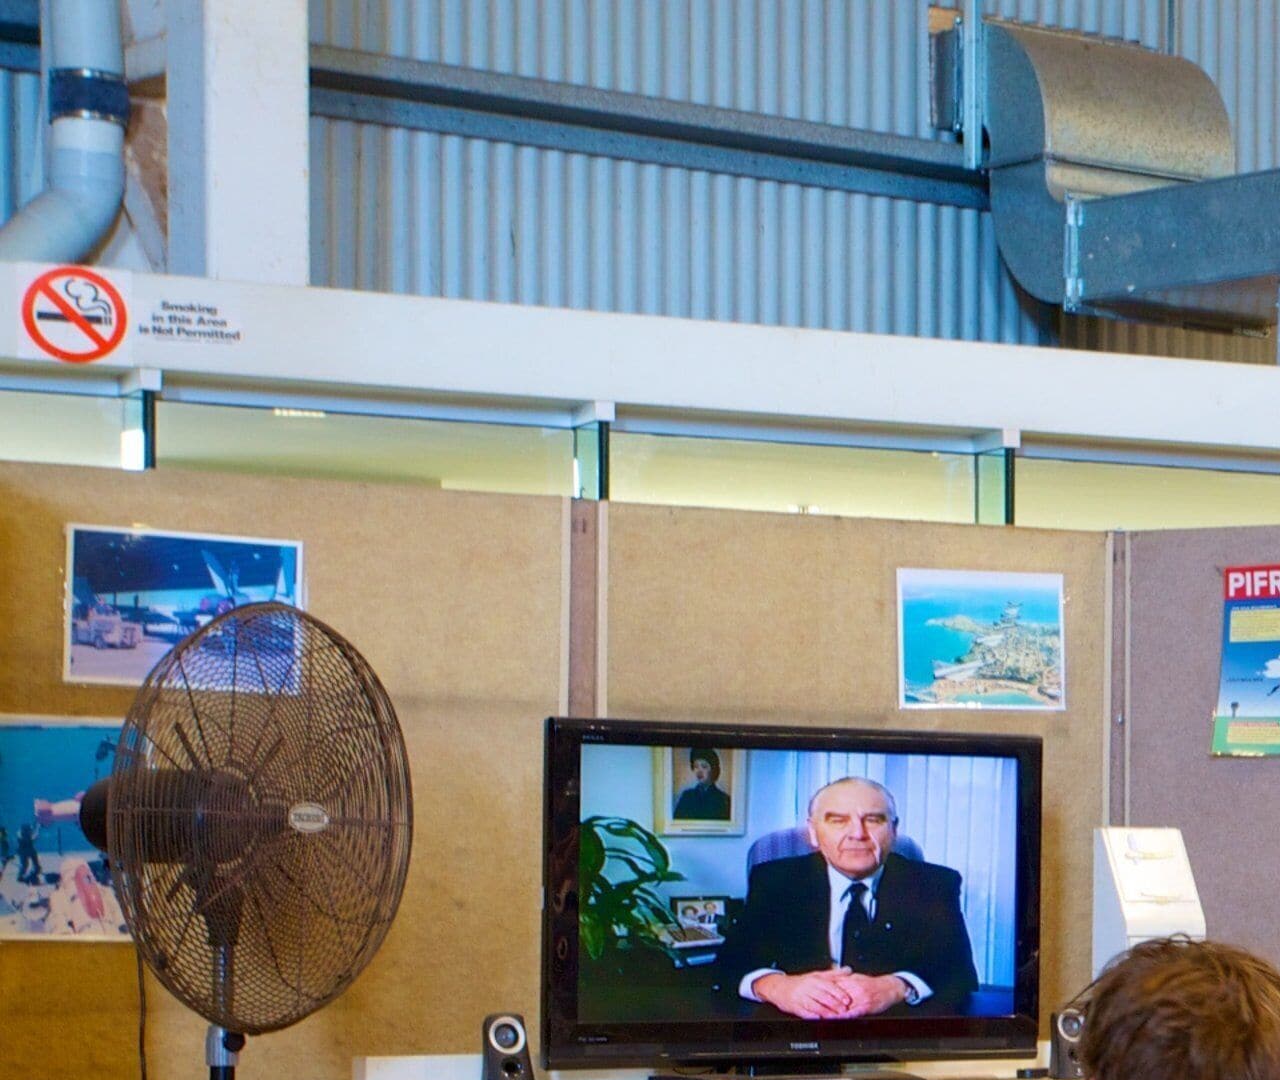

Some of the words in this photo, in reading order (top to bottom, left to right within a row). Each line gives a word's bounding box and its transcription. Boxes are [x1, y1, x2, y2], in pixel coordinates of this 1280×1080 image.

[161, 300, 217, 316] Smoking
[152, 313, 164, 323] in
[168, 315, 192, 325] this
[197, 317, 227, 327] Area
[139, 325, 150, 334] is
[152, 326, 173, 336] Not
[177, 327, 240, 341] Permitted
